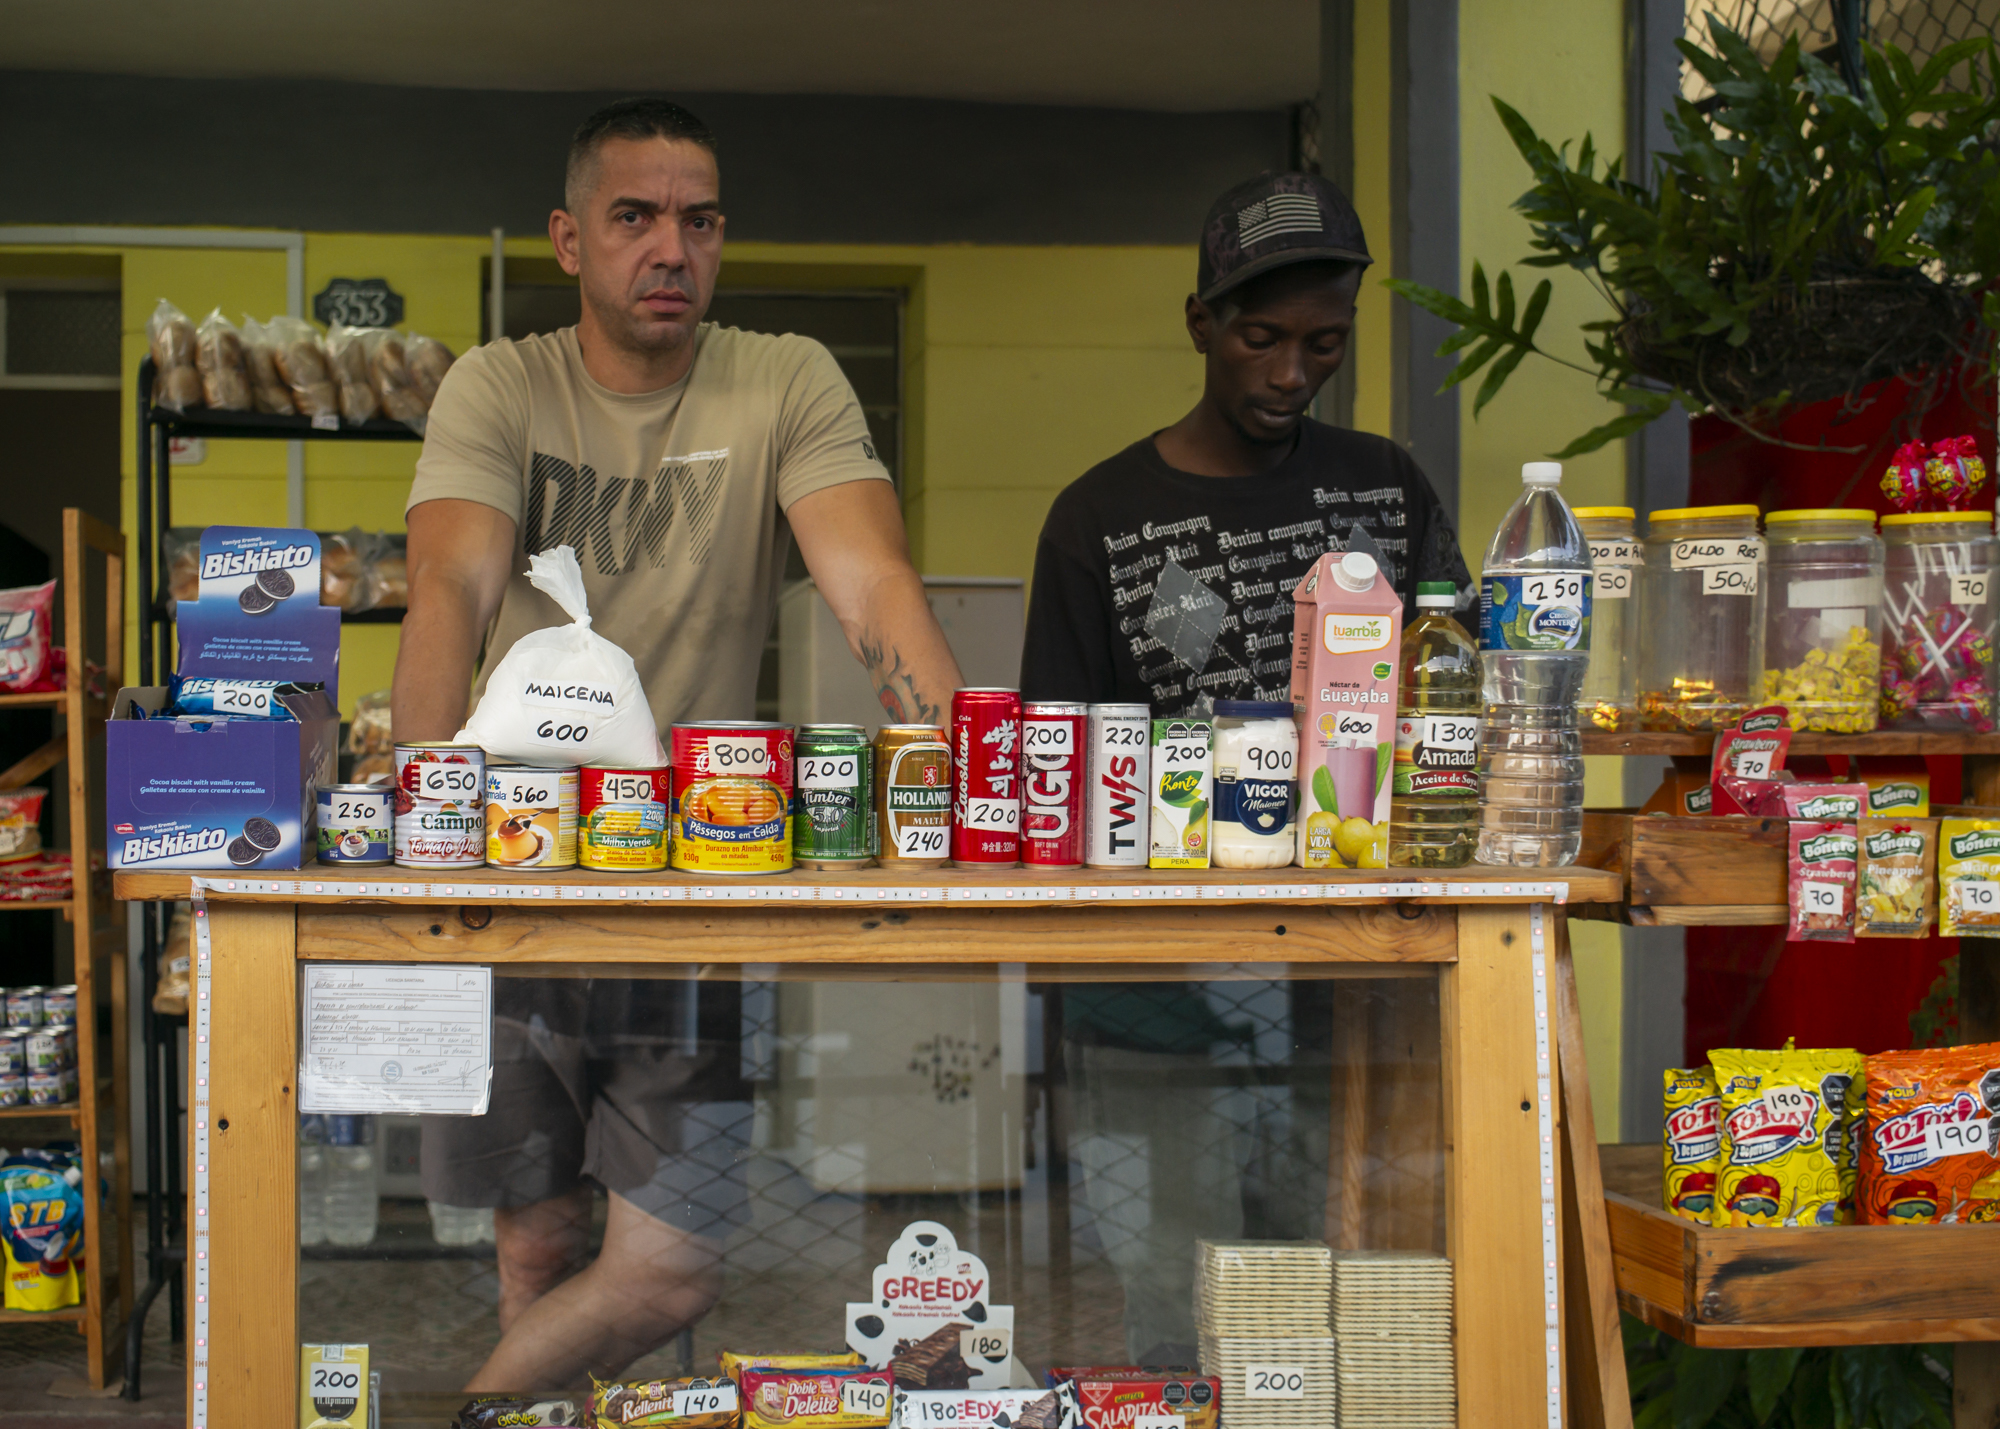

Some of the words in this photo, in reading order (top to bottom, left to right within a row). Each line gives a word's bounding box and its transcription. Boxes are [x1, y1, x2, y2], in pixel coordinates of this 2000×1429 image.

[1313, 487, 1350, 508] Denim
[524, 452, 728, 576] DKNY
[1142, 516, 1212, 540] Compagny
[1217, 528, 1263, 554] Denim
[1268, 519, 1325, 541] compagny
[1676, 544, 1724, 559] CALDO
[202, 544, 313, 579] Biskiato
[1228, 550, 1287, 574] Gangster
[1113, 582, 1154, 611] Denim
[1231, 578, 1275, 604] Denim
[1529, 578, 1578, 600] 250
[1958, 579, 1984, 596] 70
[1334, 624, 1381, 637] tuambia
[1244, 630, 1284, 658] Denim
[223, 690, 266, 708] 200
[525, 682, 614, 707] MAICENA
[1320, 688, 1389, 706] Guayaba
[536, 719, 589, 742] 600
[1339, 717, 1372, 733] 600
[1431, 722, 1476, 742] 1300
[1026, 726, 1067, 746] 200
[1105, 727, 1145, 746] 220
[714, 743, 766, 766] 800
[982, 719, 1018, 798] 崂山可
[1165, 745, 1206, 763] 200
[1247, 747, 1292, 770] 900
[1418, 749, 1476, 765] Amada
[804, 760, 853, 780] 200
[954, 725, 969, 829] Laoshan
[1743, 760, 1764, 775] 70
[426, 770, 476, 790] 650
[606, 778, 651, 800] 450
[1160, 774, 1198, 796] Pronto
[1415, 774, 1448, 786] Aceite
[1449, 773, 1461, 783] de
[1462, 774, 1477, 788] Soya
[140, 786, 167, 794] Galletas
[512, 786, 548, 803] 560
[803, 791, 849, 805] Timber
[1244, 783, 1288, 798] VIGOR
[338, 802, 376, 818] 250
[645, 810, 663, 825] 200g
[974, 804, 1017, 824] 200
[420, 813, 482, 834] Campo
[912, 816, 944, 825] MALTA
[689, 820, 736, 841] Pêssegos
[739, 831, 750, 839] em
[753, 823, 779, 838] Calda
[1310, 827, 1331, 836] LARGA
[122, 826, 227, 864] Biskiato
[408, 836, 454, 857] Tomato
[602, 836, 626, 847] Milho
[628, 838, 651, 847] Verde
[705, 844, 730, 852] Durazno
[741, 844, 764, 852] Almíbar
[906, 831, 944, 853] 240
[1310, 837, 1331, 848] VIDA
[1955, 838, 2000, 854] Boner
[683, 853, 699, 863] 830g
[1867, 864, 1923, 880] Pineapple
[1810, 890, 1834, 905] 70
[1966, 888, 1993, 904] 70
[1771, 1094, 1801, 1110] 190
[1936, 1124, 1982, 1150] 190
[883, 1276, 983, 1302] GREEDY
[971, 1337, 1001, 1354] 180
[315, 1369, 358, 1388] 200
[1254, 1372, 1302, 1392] 200
[605, 1385, 621, 1400] NUEVA
[765, 1388, 777, 1401] GN
[789, 1382, 818, 1395] Doble
[684, 1394, 719, 1415] 140
[785, 1396, 838, 1418] Deleite
[850, 1389, 885, 1410] 140
[922, 1402, 957, 1420] 180
[1084, 1401, 1174, 1429] SALADITAS
